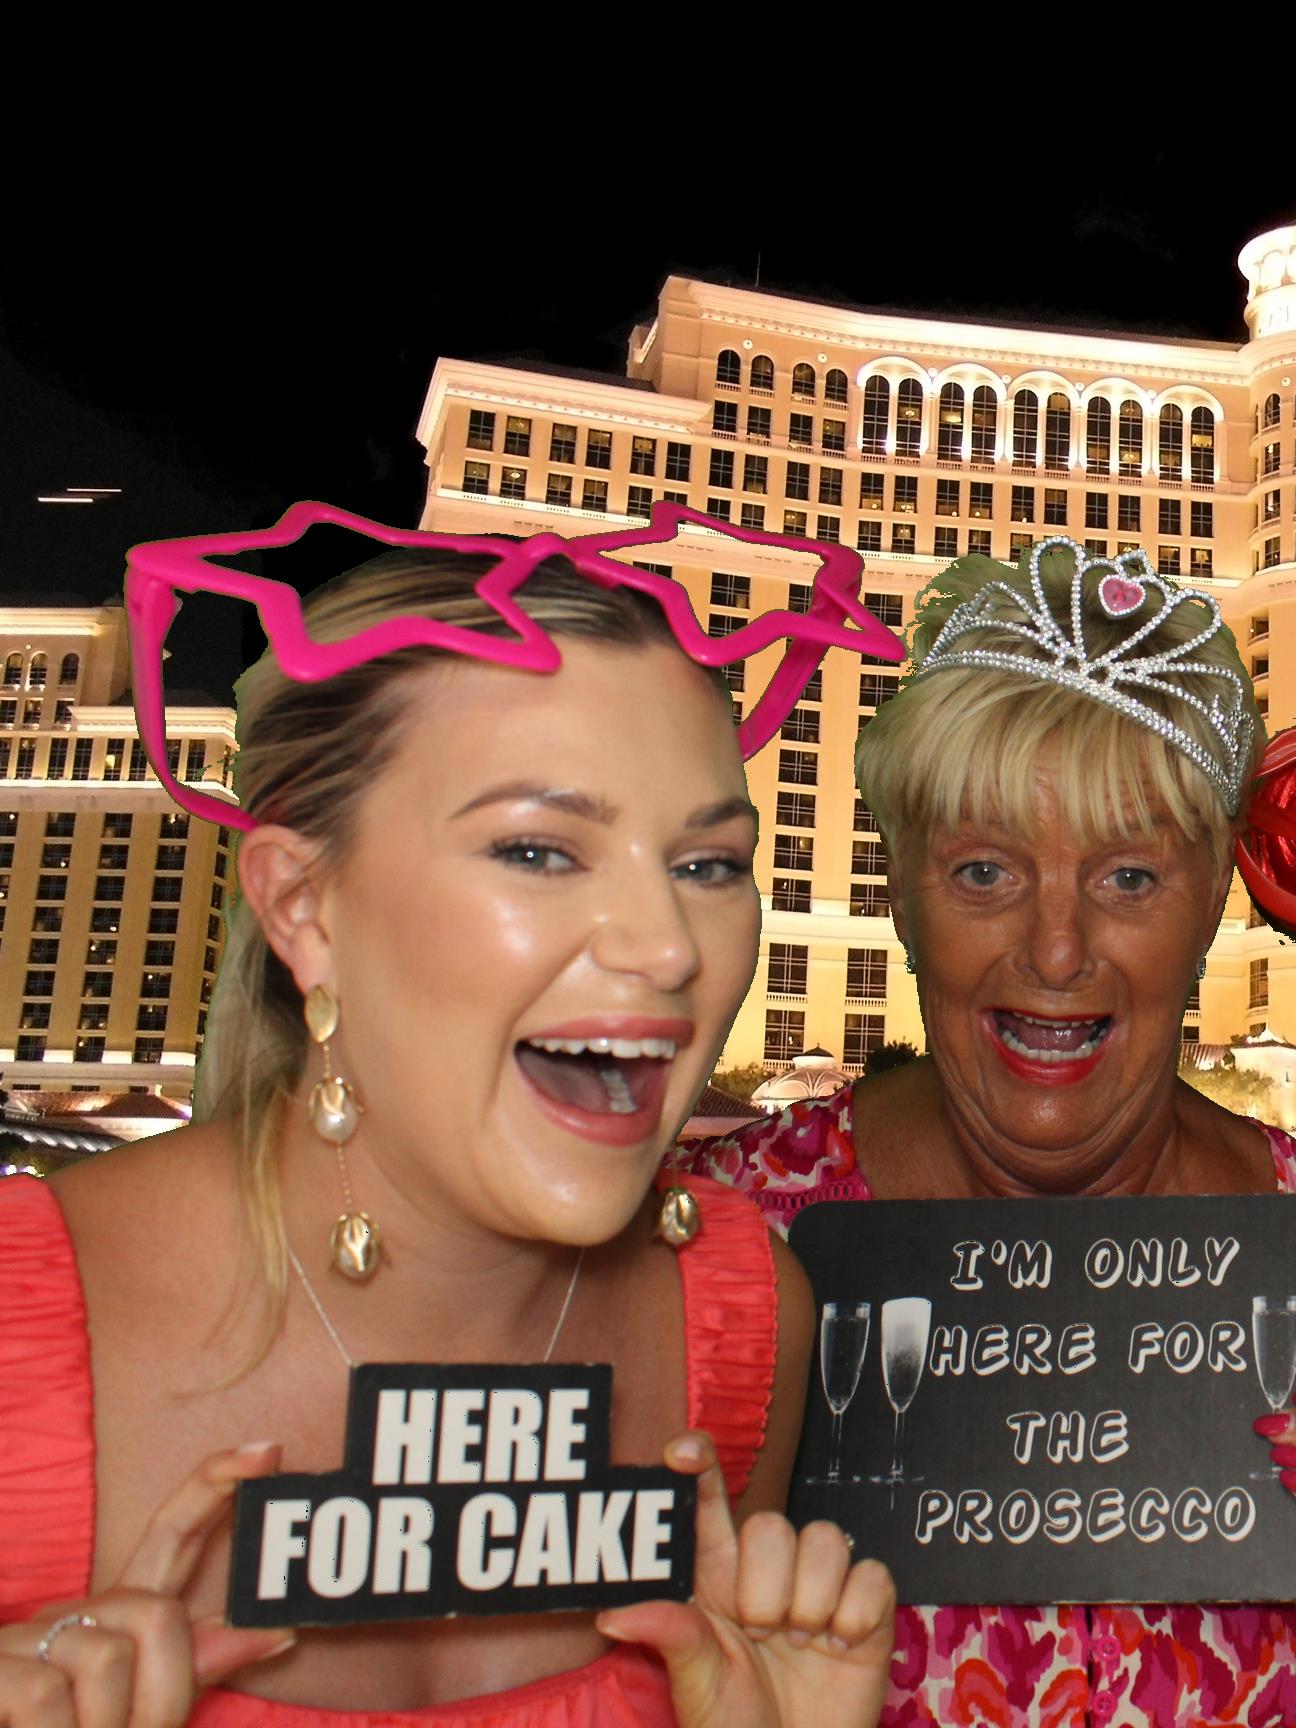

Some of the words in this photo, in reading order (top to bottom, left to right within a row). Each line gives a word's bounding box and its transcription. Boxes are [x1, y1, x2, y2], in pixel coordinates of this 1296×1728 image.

[949, 1238, 1053, 1292] I'M
[1084, 1235, 1242, 1289] ONLY
[928, 1322, 1098, 1377] HERE
[1127, 1320, 1248, 1375] FOR
[372, 1388, 590, 1486] HERE
[1006, 1408, 1130, 1465] THE
[257, 1495, 435, 1600] FOR
[456, 1488, 676, 1591] CAKE
[914, 1485, 1258, 1546] PROSECCO
